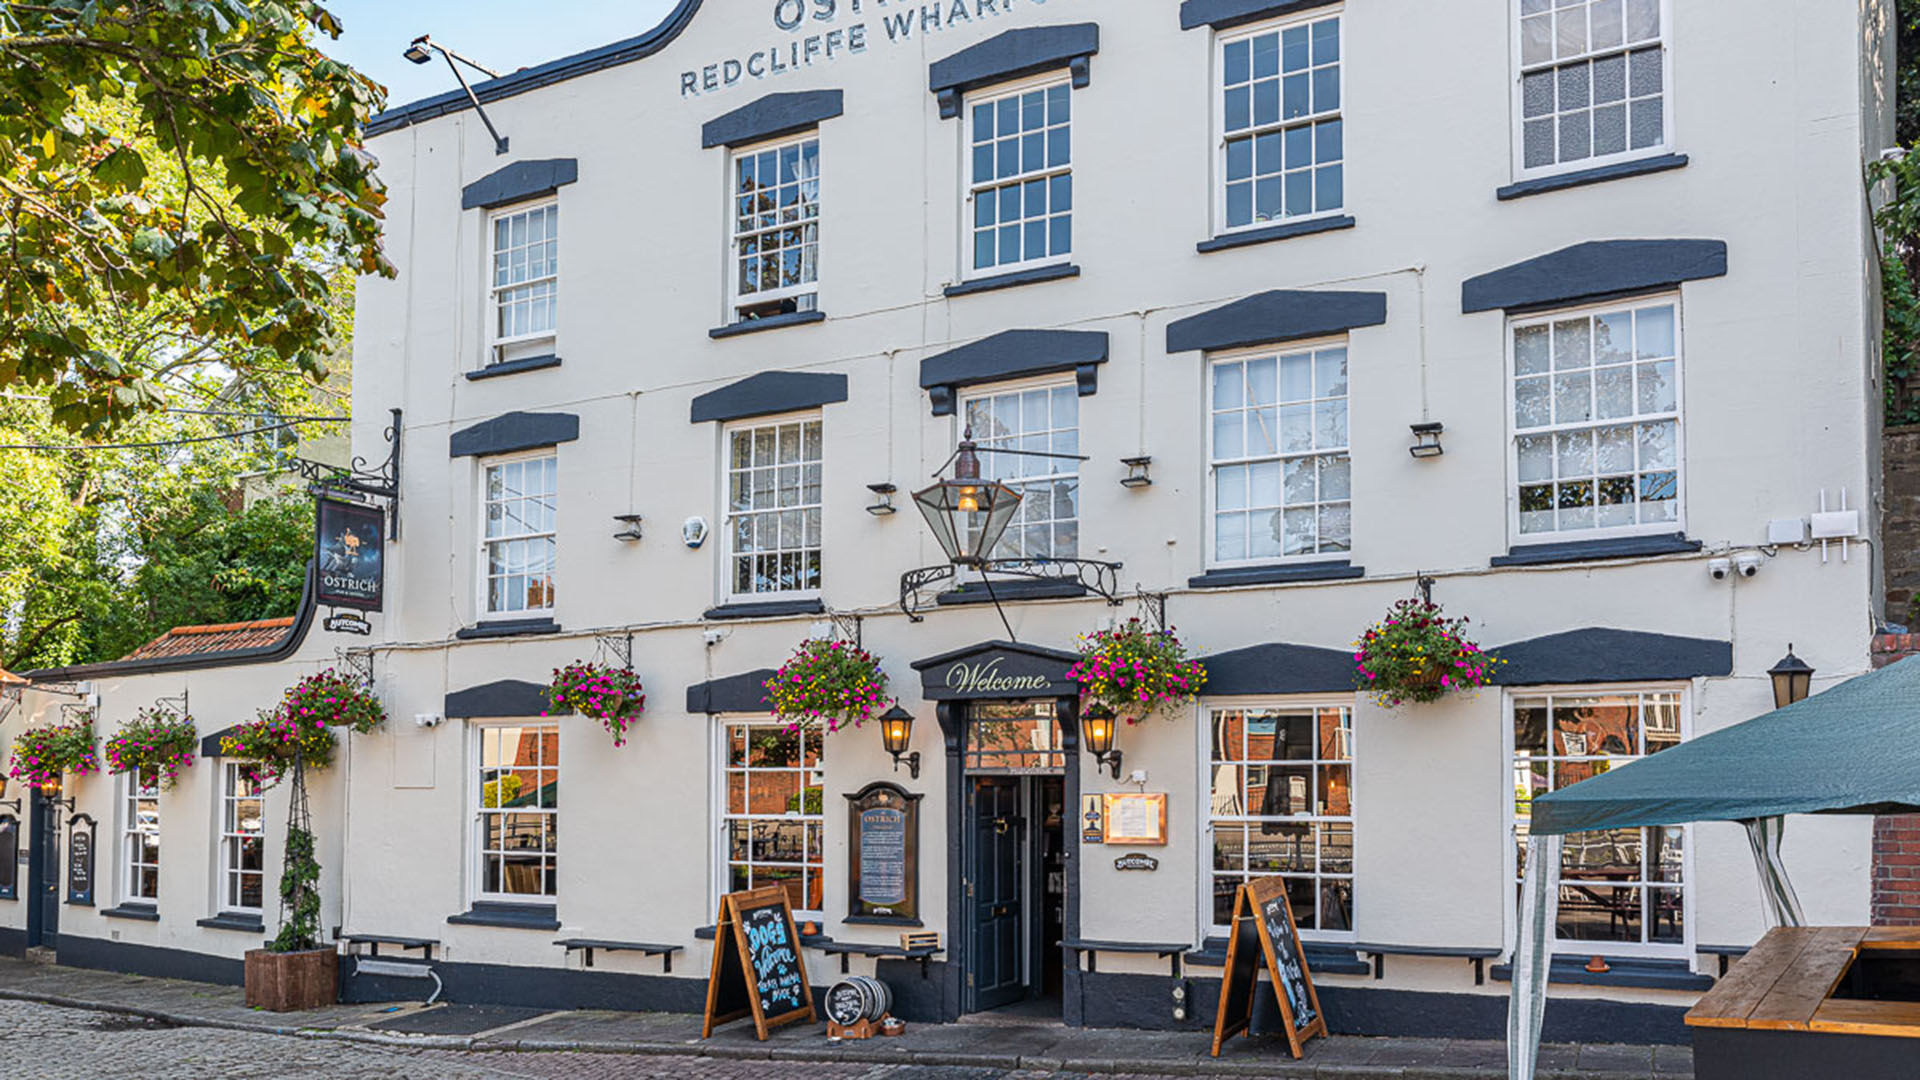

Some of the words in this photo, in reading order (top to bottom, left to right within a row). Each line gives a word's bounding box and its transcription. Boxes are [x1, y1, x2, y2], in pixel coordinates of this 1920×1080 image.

[680, 23, 866, 96] REDCLIFFE
[324, 575, 376, 592] OSTRICH
[946, 657, 1051, 694] Welcome
